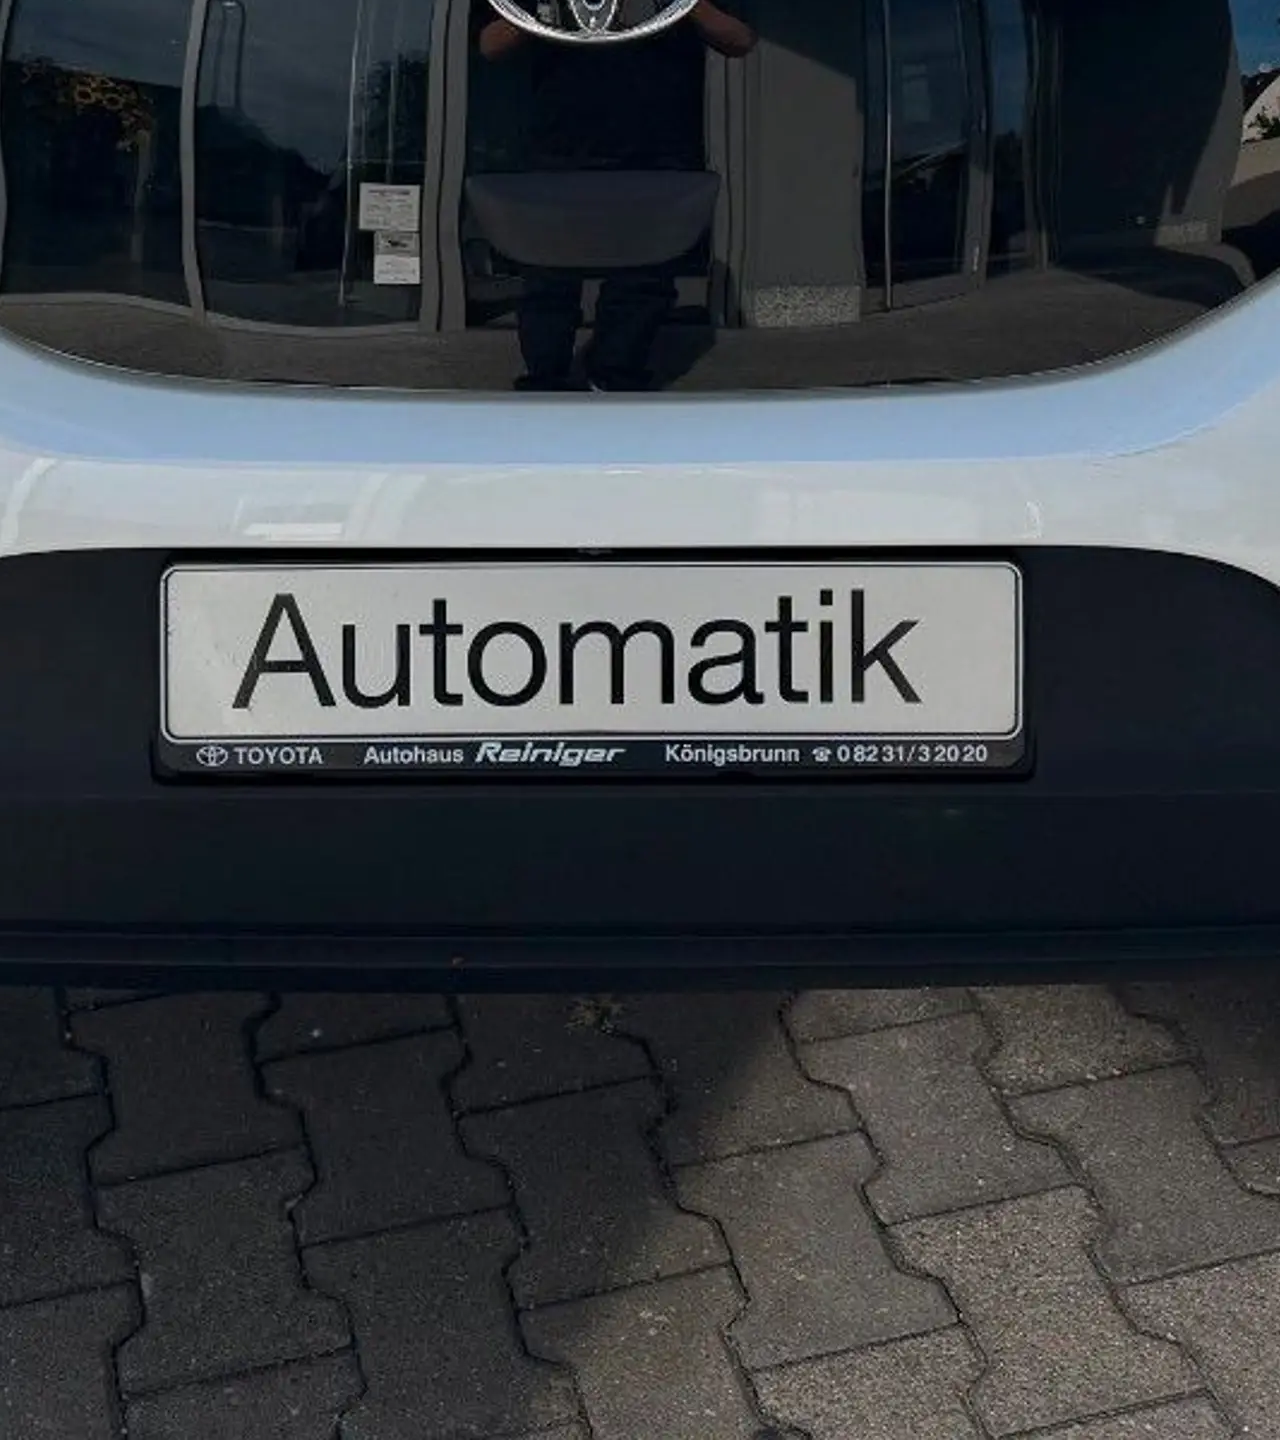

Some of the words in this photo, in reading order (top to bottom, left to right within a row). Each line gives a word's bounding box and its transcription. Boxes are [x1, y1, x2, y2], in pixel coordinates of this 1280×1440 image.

[231, 588, 923, 710] Automatik
[233, 746, 324, 765] TOYOTA
[363, 745, 465, 765] Autohaus
[474, 741, 627, 768] Reiniger
[665, 743, 800, 767] Königsbrunn
